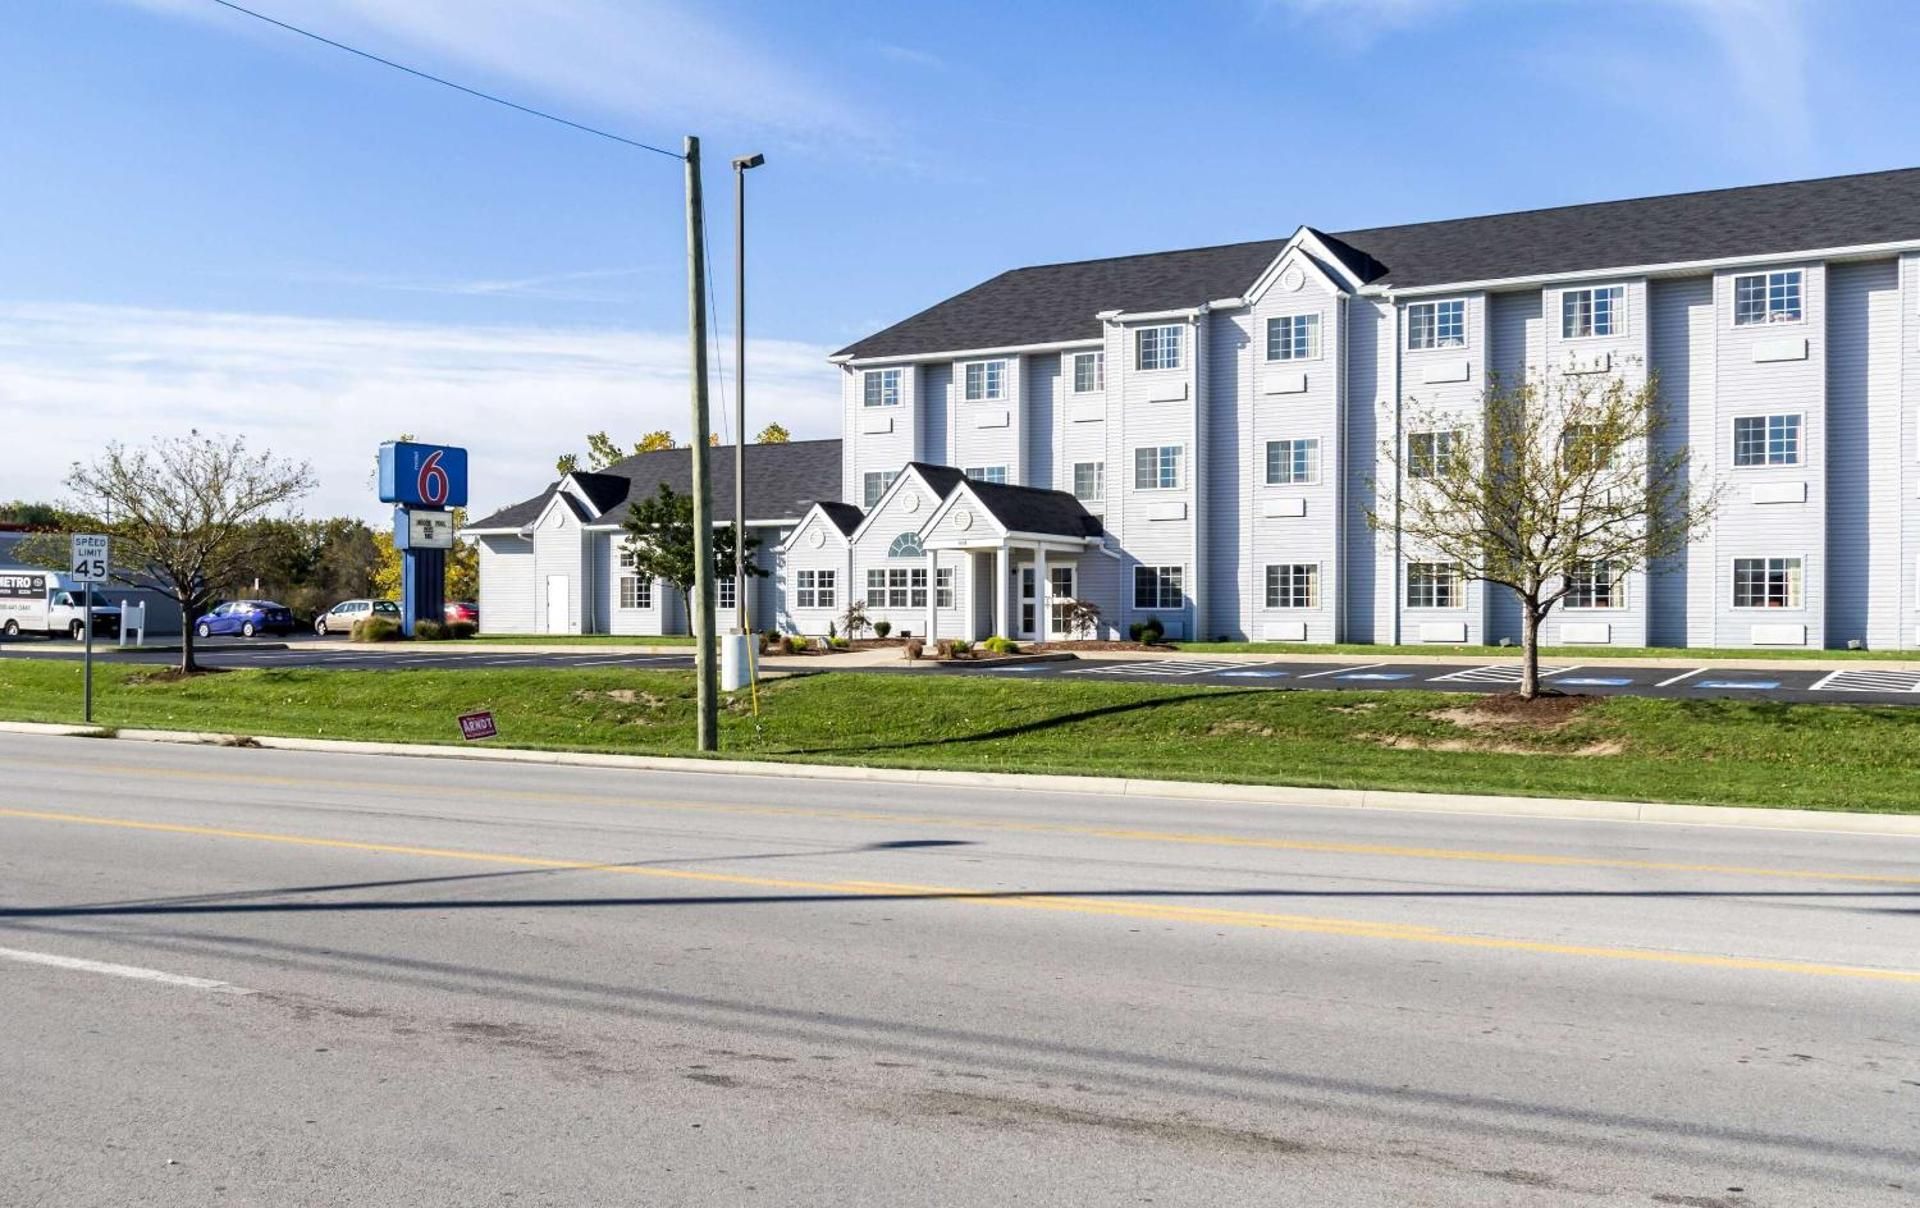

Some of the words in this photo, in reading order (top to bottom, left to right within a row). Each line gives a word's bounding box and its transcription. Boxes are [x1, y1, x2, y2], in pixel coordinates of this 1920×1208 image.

[417, 450, 449, 506] 6
[75, 537, 107, 547] SPEED
[78, 548, 103, 557] LIMIT
[75, 560, 106, 577] 45
